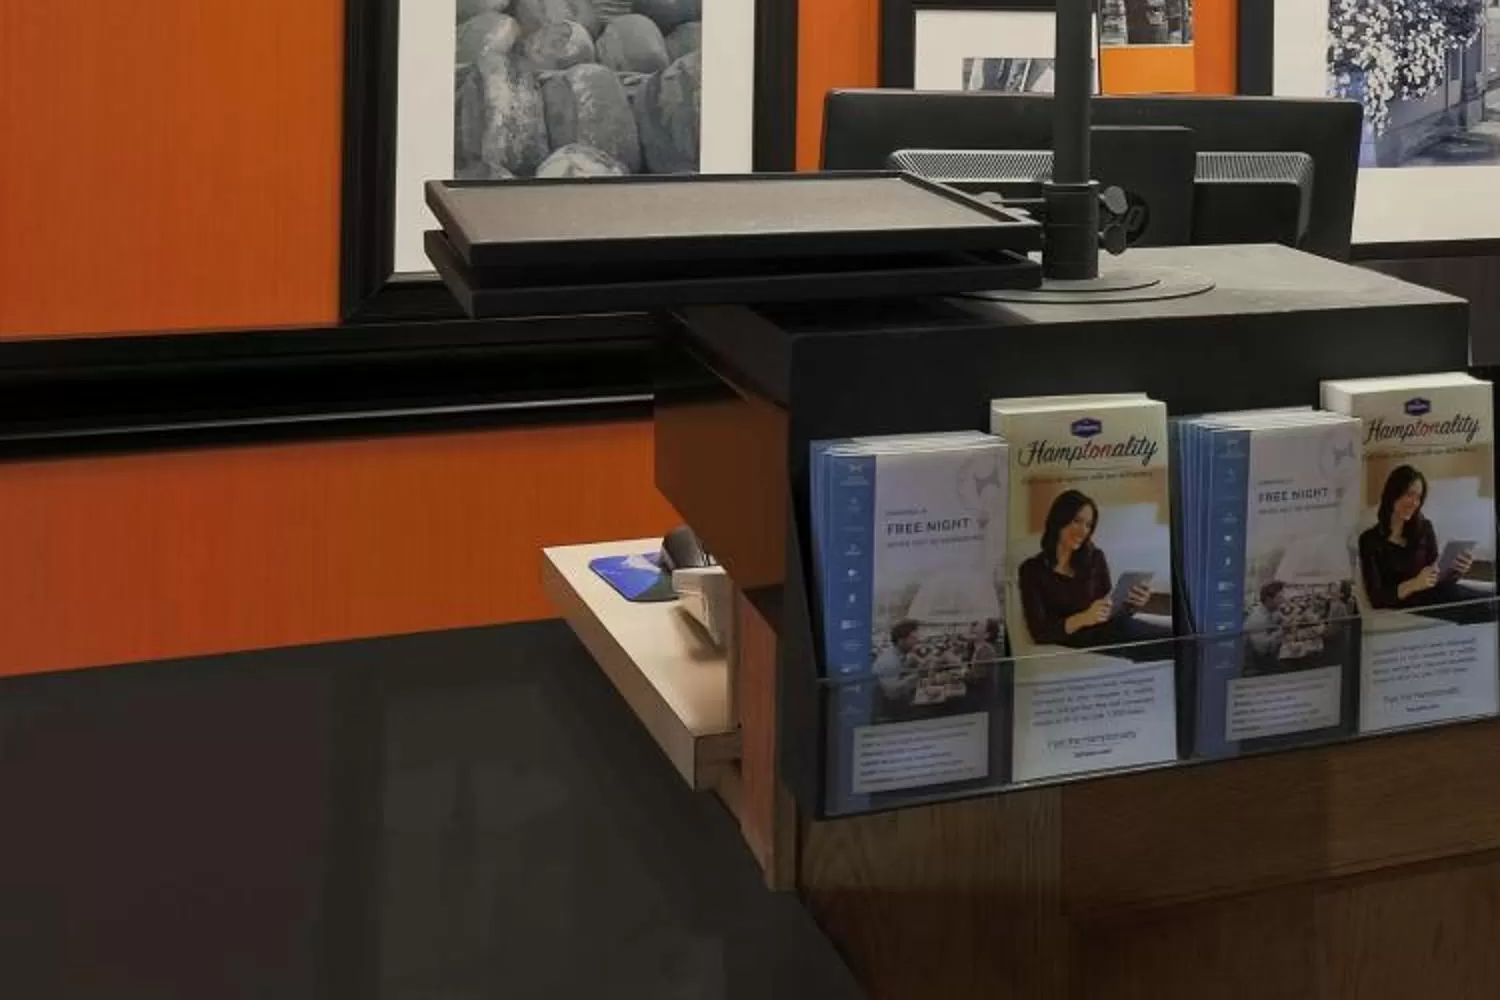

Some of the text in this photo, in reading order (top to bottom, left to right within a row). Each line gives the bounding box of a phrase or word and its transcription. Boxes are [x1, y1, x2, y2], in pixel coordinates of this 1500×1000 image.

[1362, 413, 1481, 445] Hamptonality
[1018, 433, 1158, 467] Hamptonality
[1257, 487, 1329, 504] FREE NIGHT
[886, 517, 972, 536] FREE NIGHT
